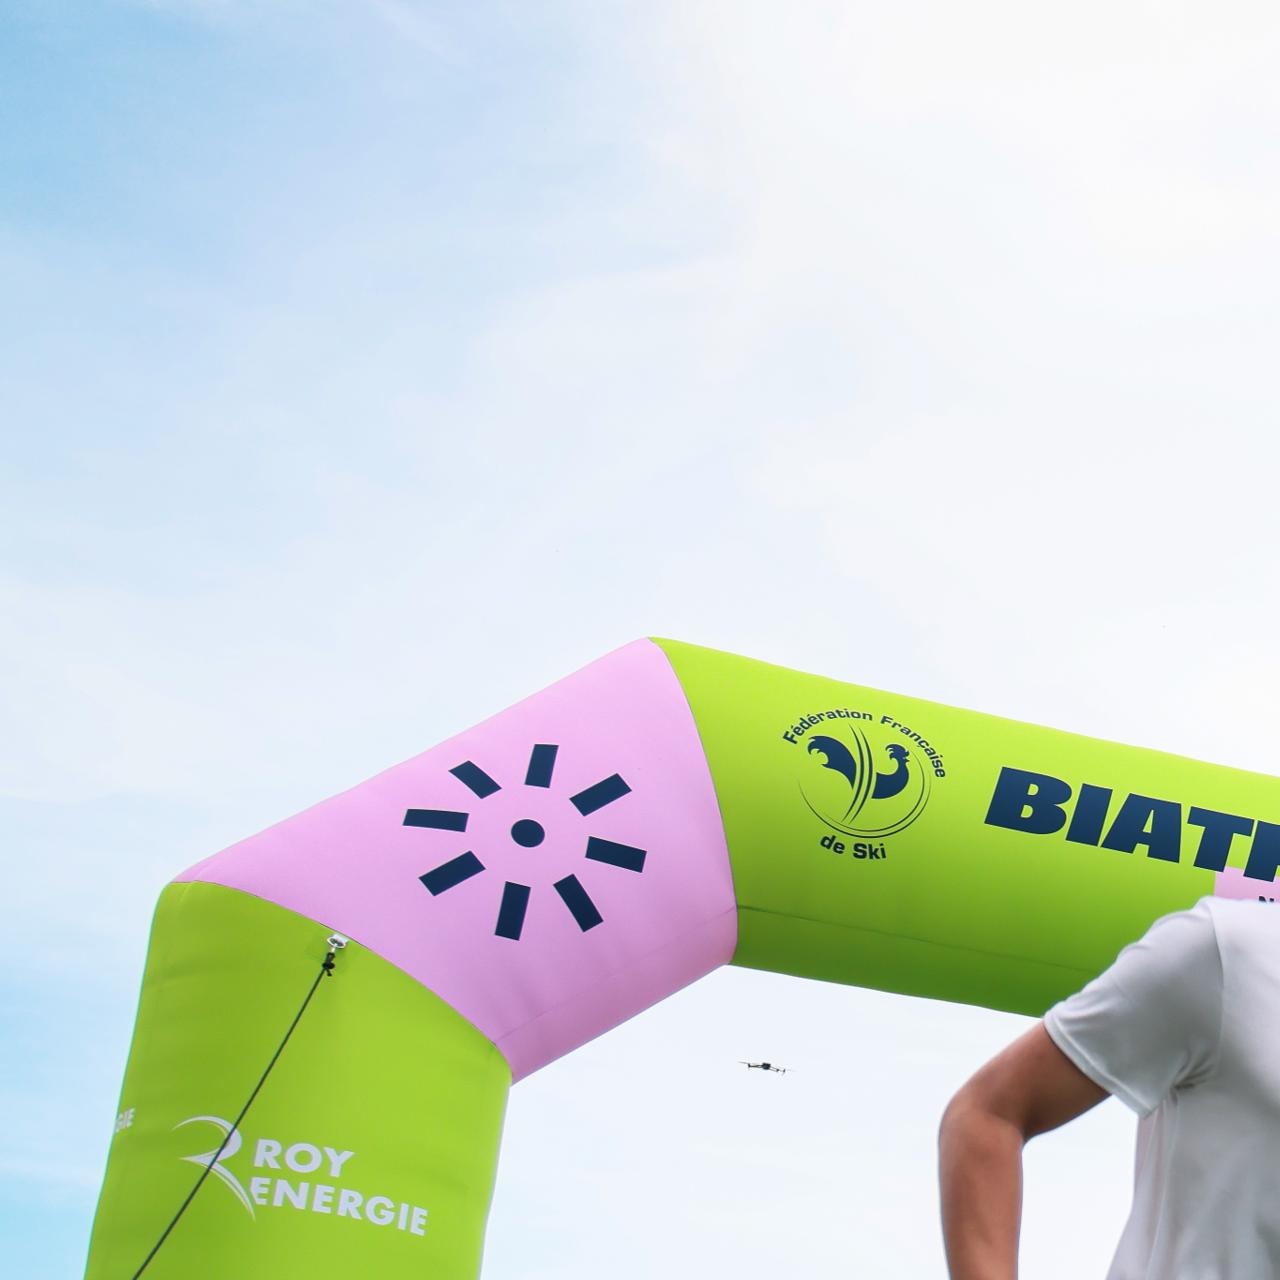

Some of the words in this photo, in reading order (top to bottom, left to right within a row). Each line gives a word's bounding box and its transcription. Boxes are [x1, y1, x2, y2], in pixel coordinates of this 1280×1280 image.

[782, 708, 873, 745] Fédération
[880, 715, 946, 778] Française
[820, 835, 846, 855] de
[853, 843, 887, 860] Ski
[253, 1138, 355, 1178] ROY
[250, 1176, 429, 1237] ENERGIE
